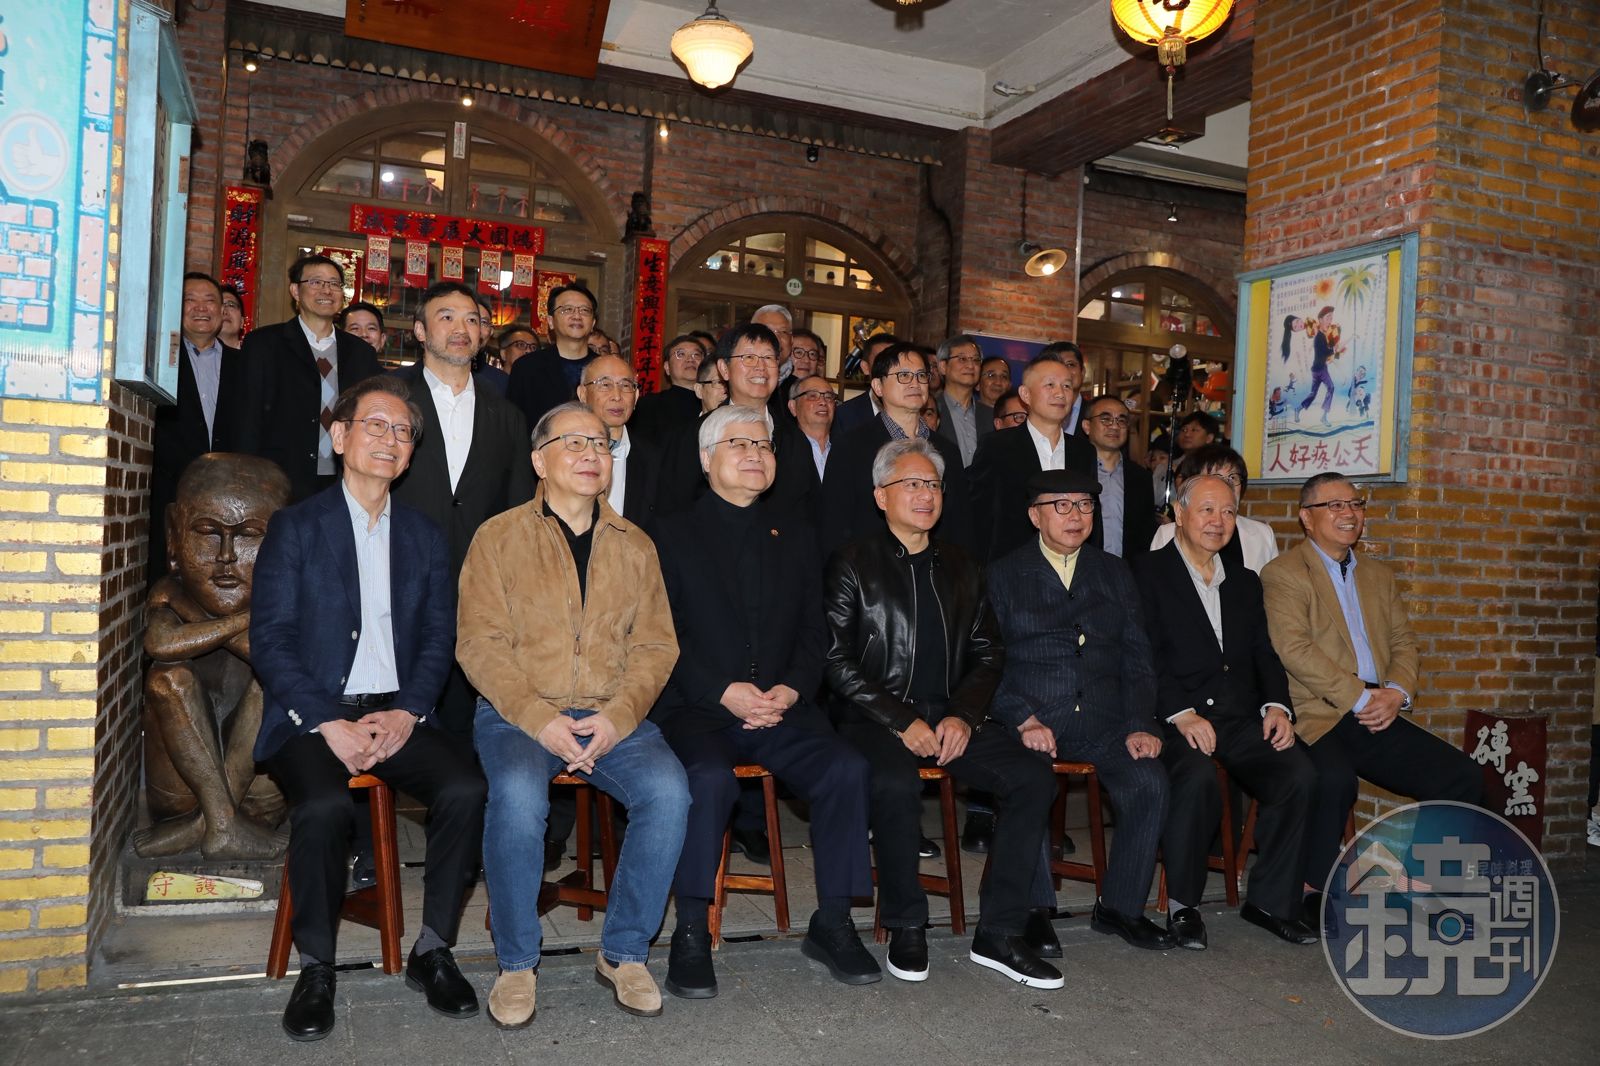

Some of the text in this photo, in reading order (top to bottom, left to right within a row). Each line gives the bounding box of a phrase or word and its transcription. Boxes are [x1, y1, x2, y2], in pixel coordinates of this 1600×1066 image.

[637, 253, 662, 393] 生意興隆年年旺
[1269, 433, 1373, 473] 天公疼好人
